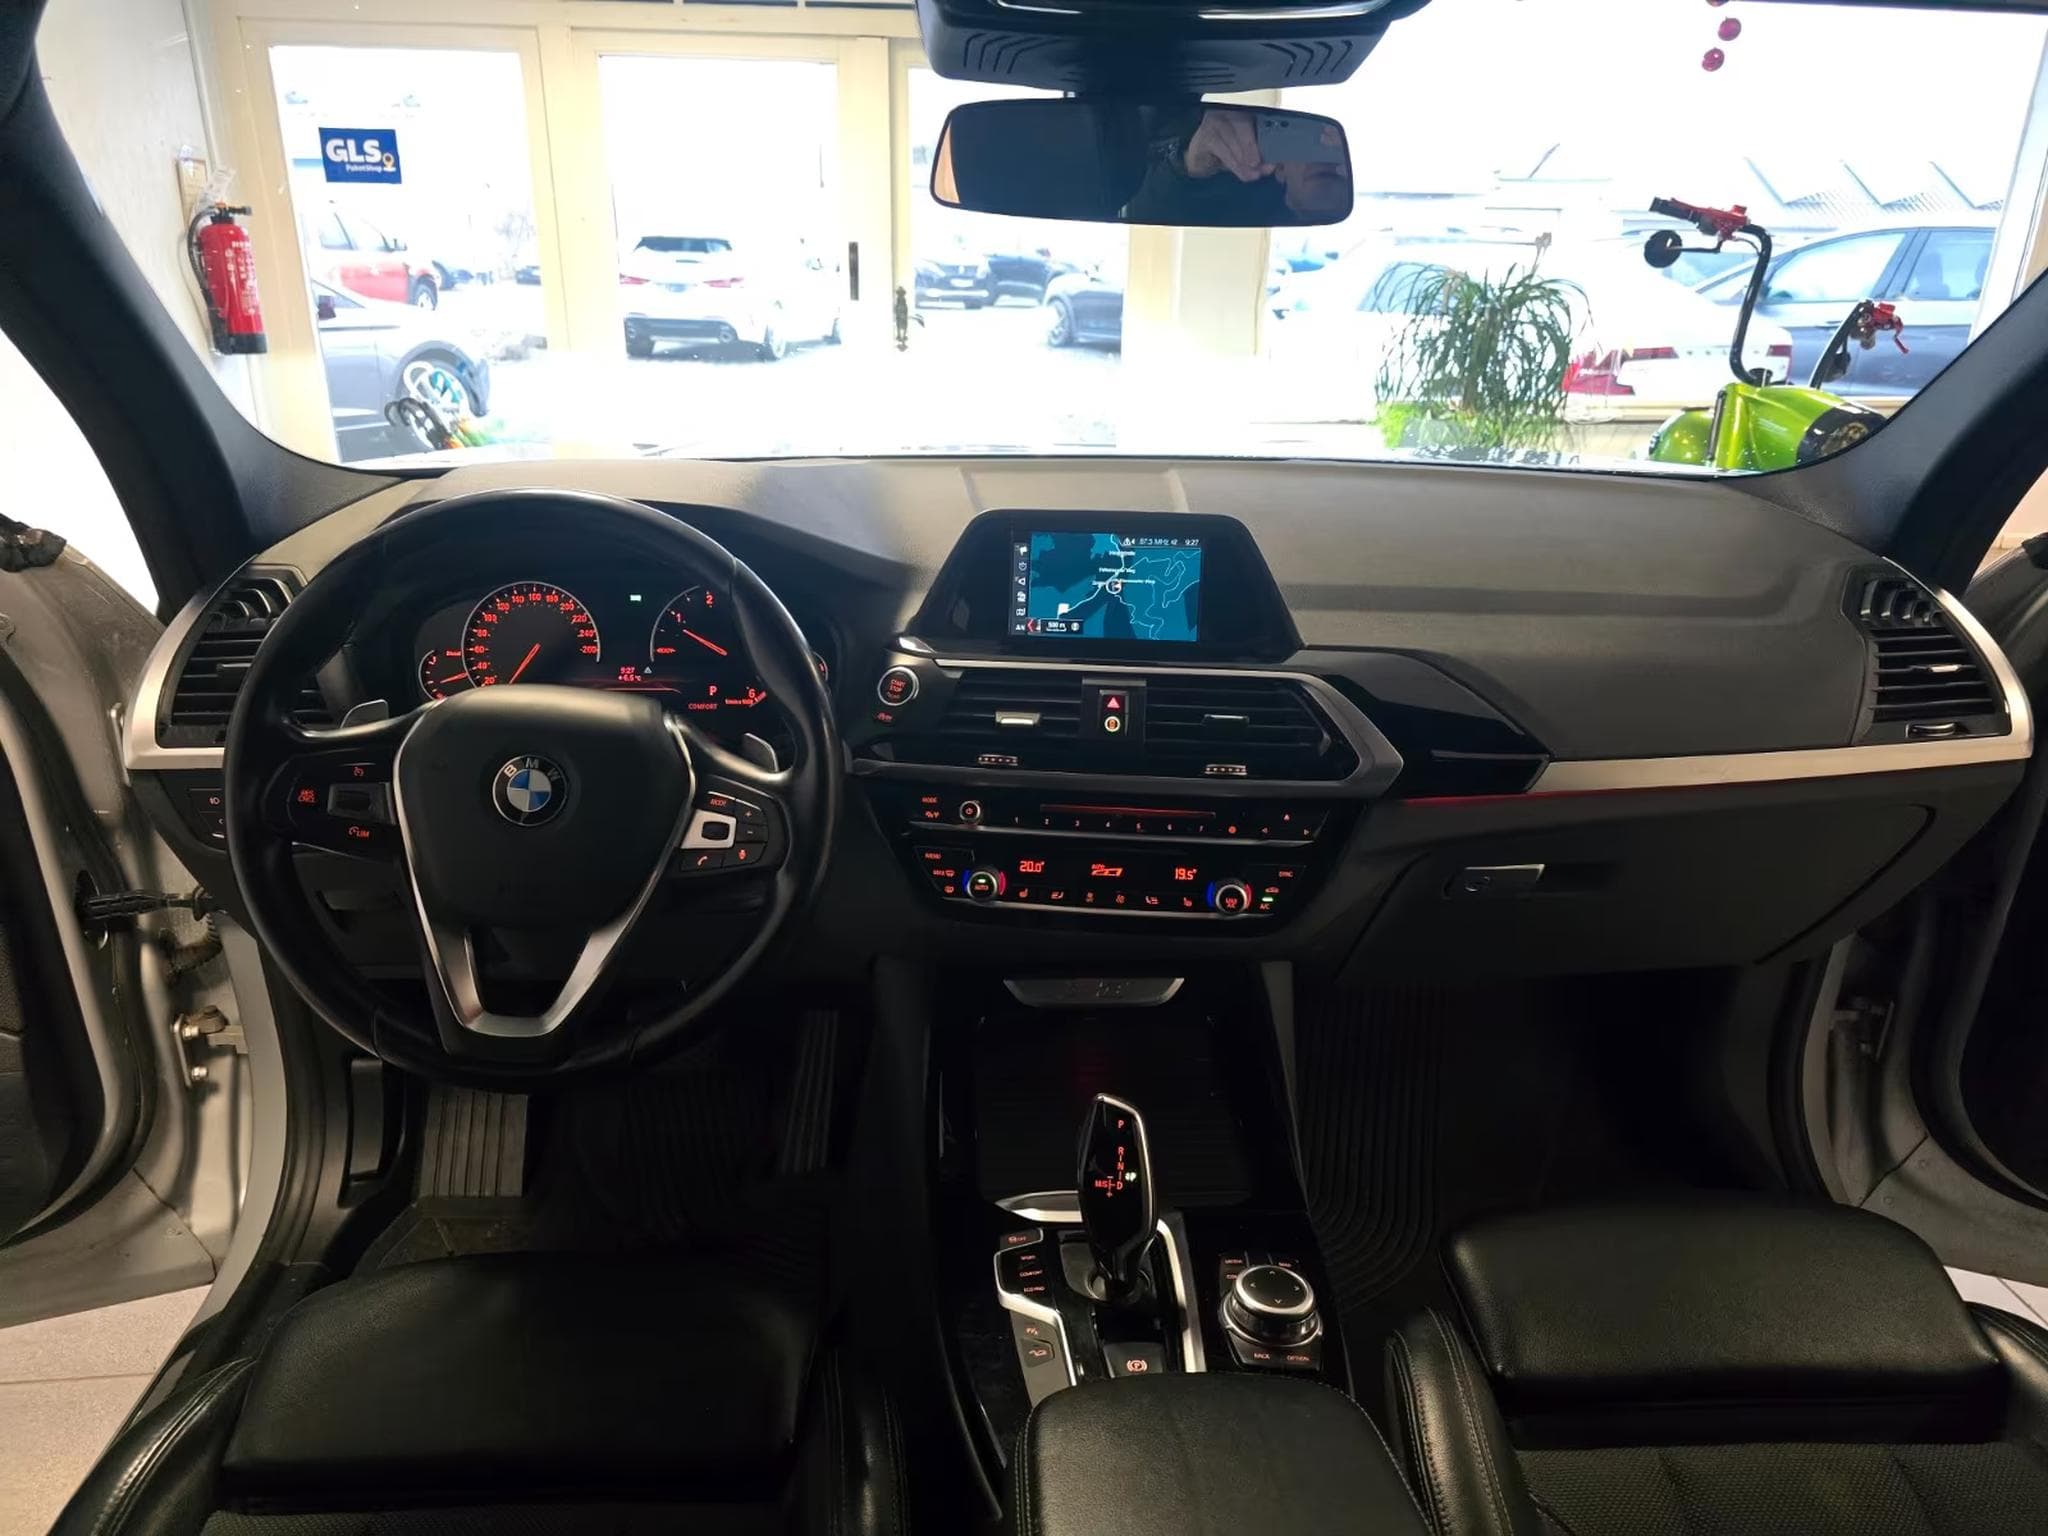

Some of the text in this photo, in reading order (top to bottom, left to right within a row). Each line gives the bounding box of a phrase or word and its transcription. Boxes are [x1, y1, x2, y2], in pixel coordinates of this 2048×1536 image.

[326, 138, 382, 163] GLS
[504, 757, 561, 781] BMW
[1118, 1120, 1125, 1129] P
[1118, 1146, 1125, 1155] R
[1116, 1181, 1123, 1190] D
